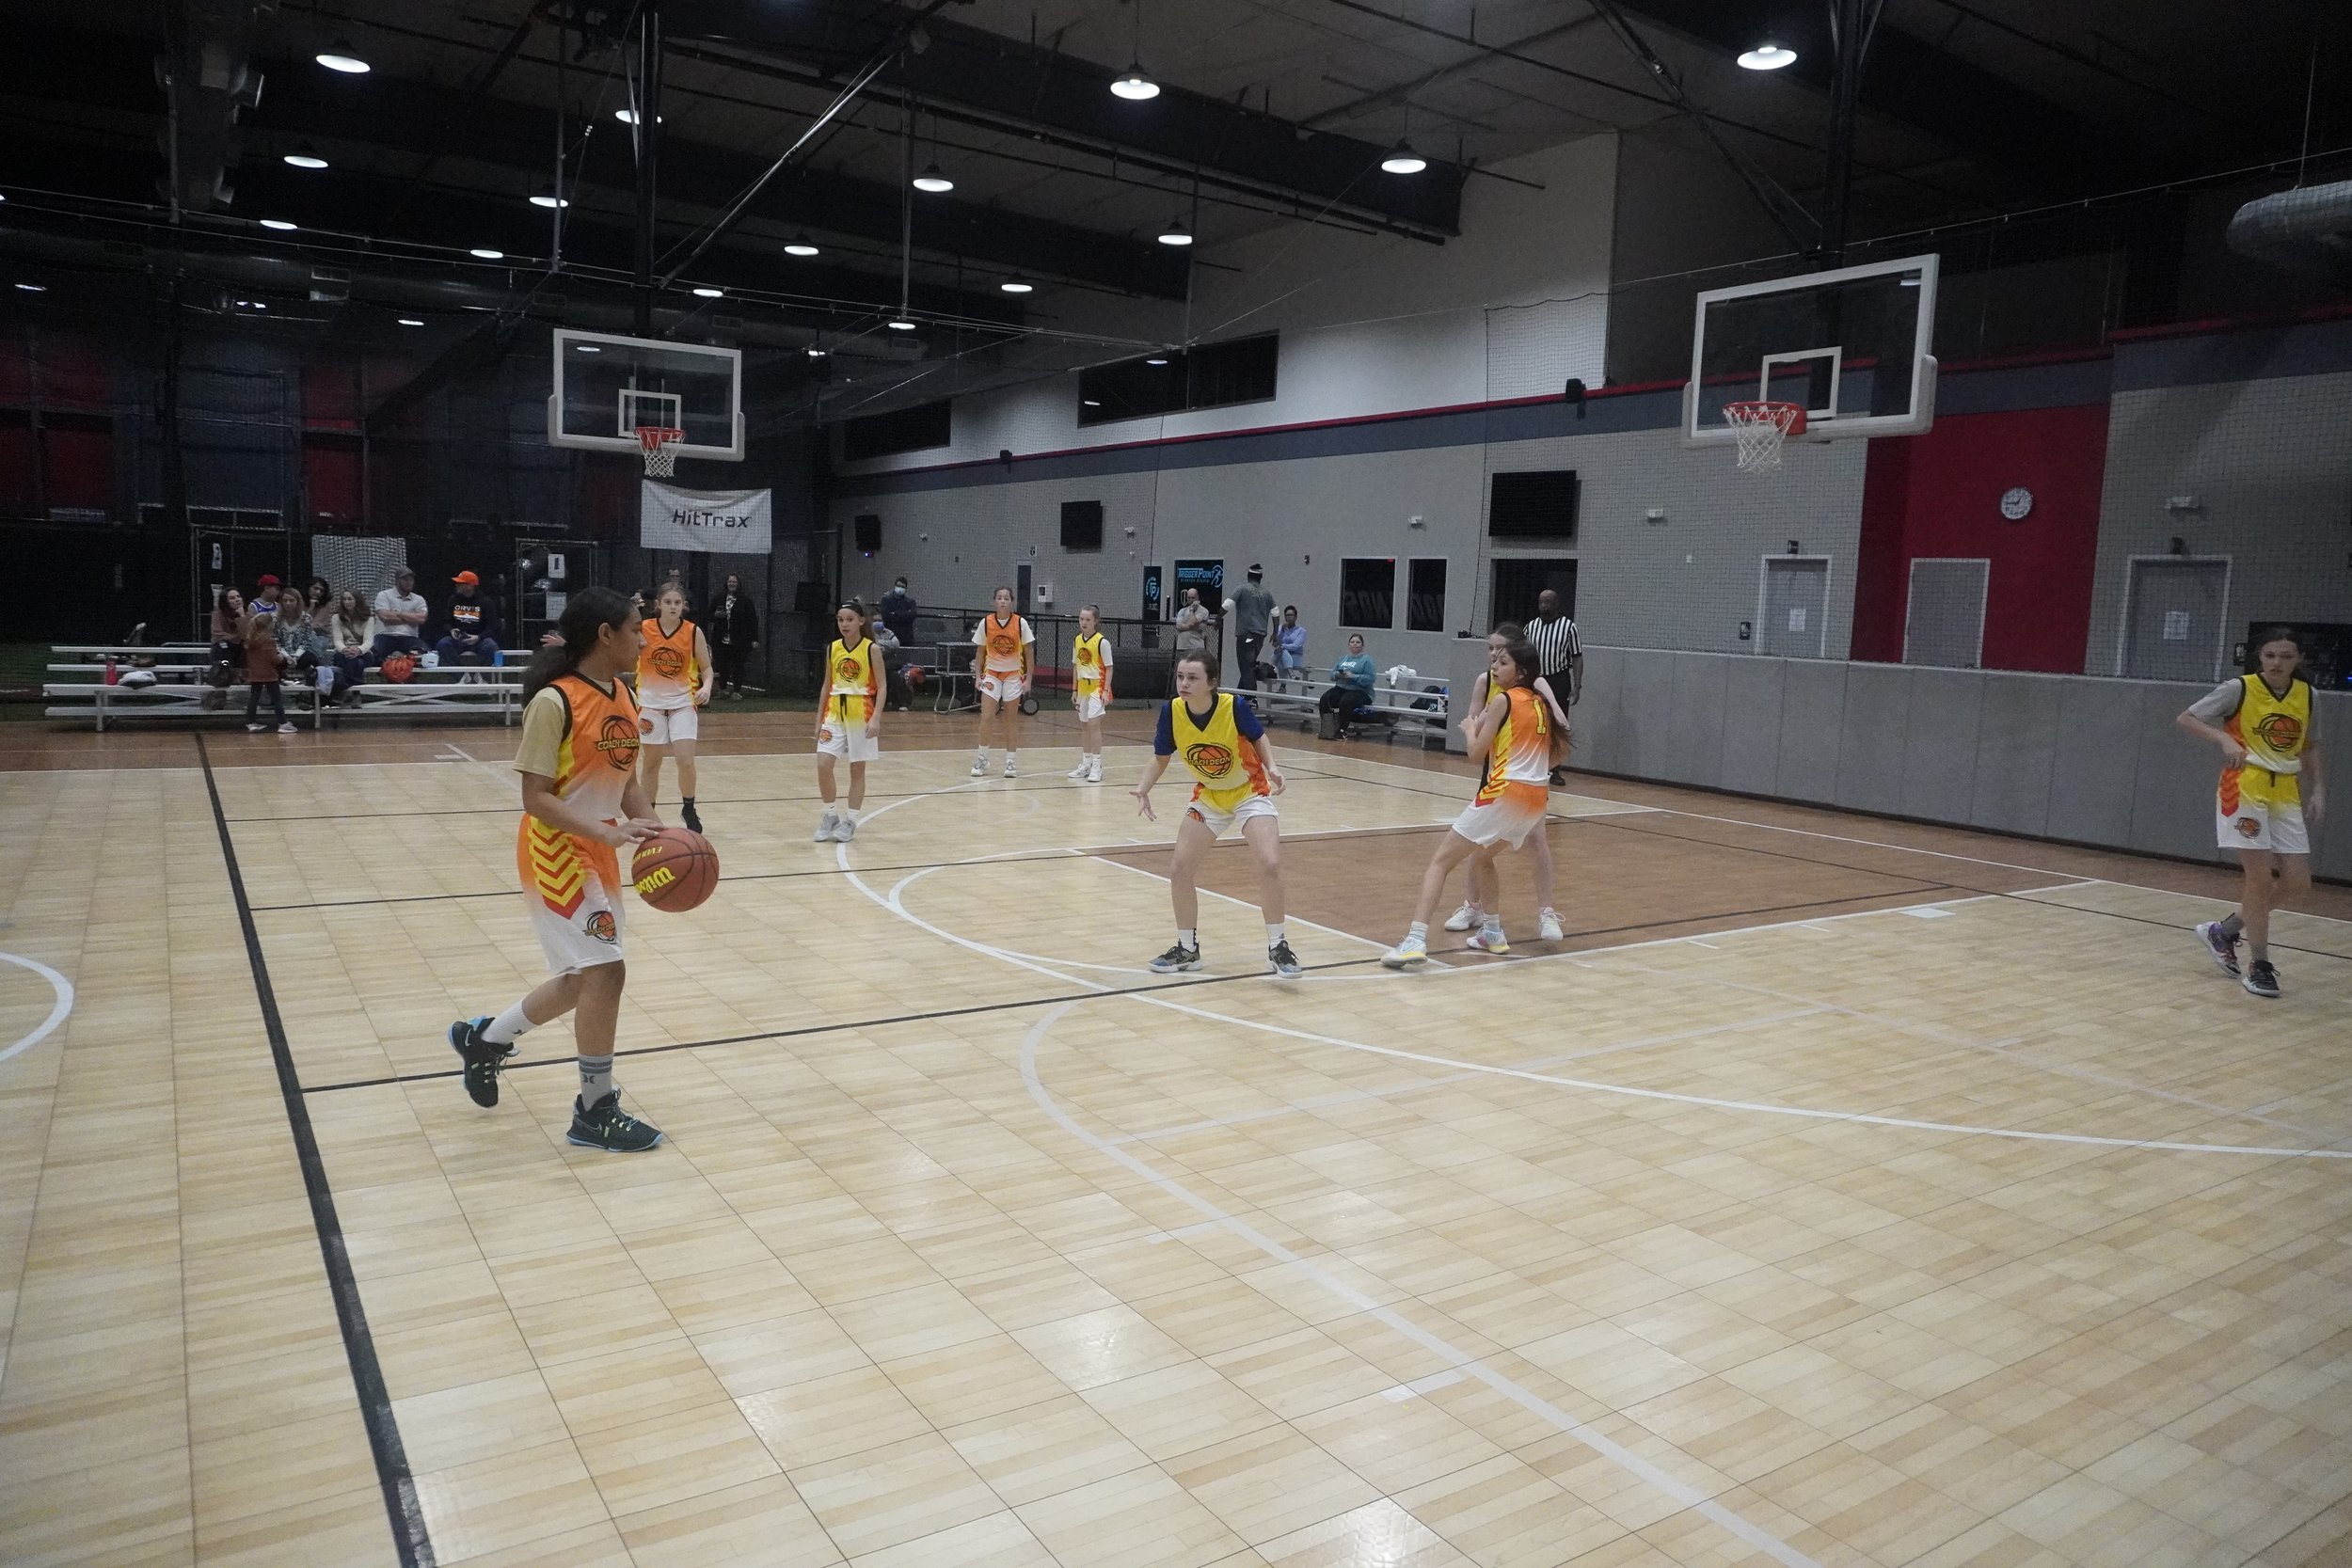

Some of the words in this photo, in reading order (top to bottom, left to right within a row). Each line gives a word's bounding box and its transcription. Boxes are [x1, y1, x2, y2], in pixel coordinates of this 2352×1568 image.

[672, 509, 749, 529] HitTrax
[596, 739, 621, 750] COACH
[1209, 757, 1231, 766] DEON
[635, 866, 676, 894] Wilso
